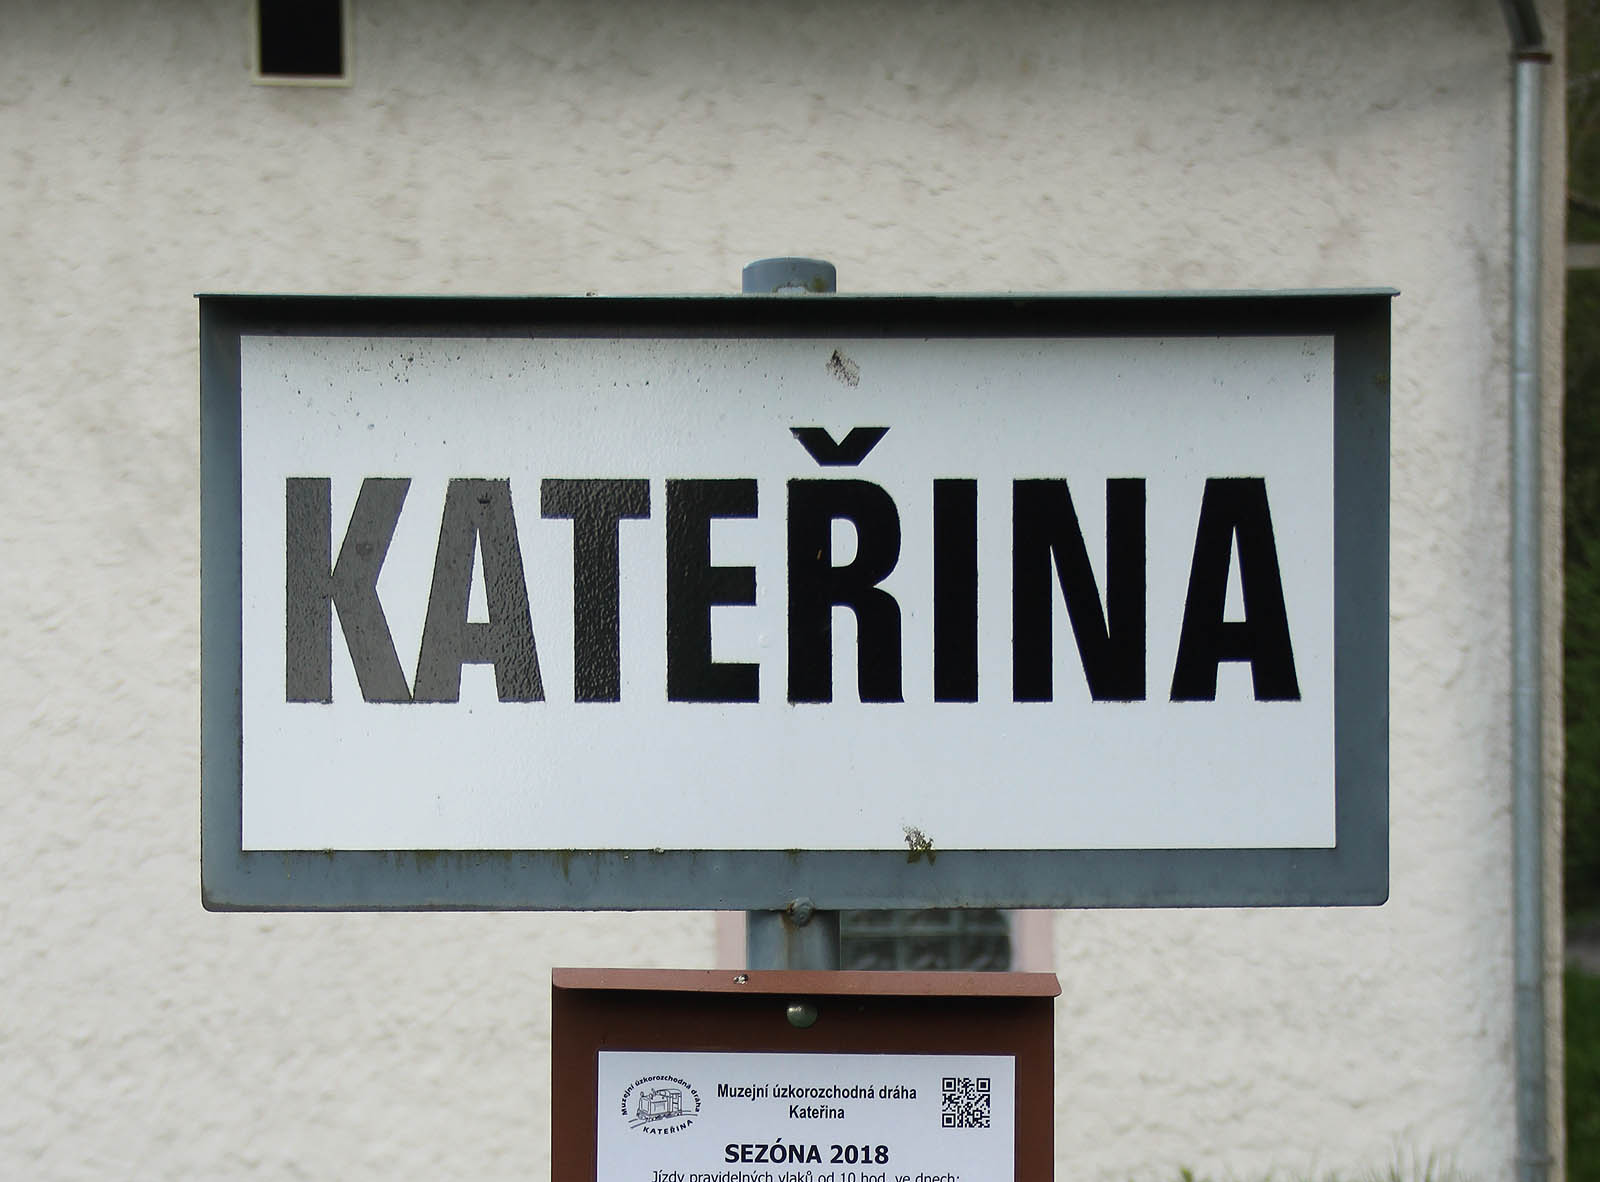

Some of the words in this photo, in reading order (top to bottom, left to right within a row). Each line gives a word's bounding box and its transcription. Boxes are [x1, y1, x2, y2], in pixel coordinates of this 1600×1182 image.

[285, 427, 1302, 704] KATEŘINA
[621, 1082, 635, 1116] Muzejní
[634, 1074, 692, 1090] úzkorozchodná
[690, 1089, 701, 1113] dráha
[718, 1083, 769, 1101] Muzejní
[773, 1084, 875, 1099] úzkorozchodná
[879, 1085, 917, 1099] dráha
[789, 1105, 845, 1119] Kateřina
[642, 1119, 693, 1135] KATEŘINA
[725, 1137, 822, 1164] SEZÓNA
[830, 1144, 889, 1164] 2018
